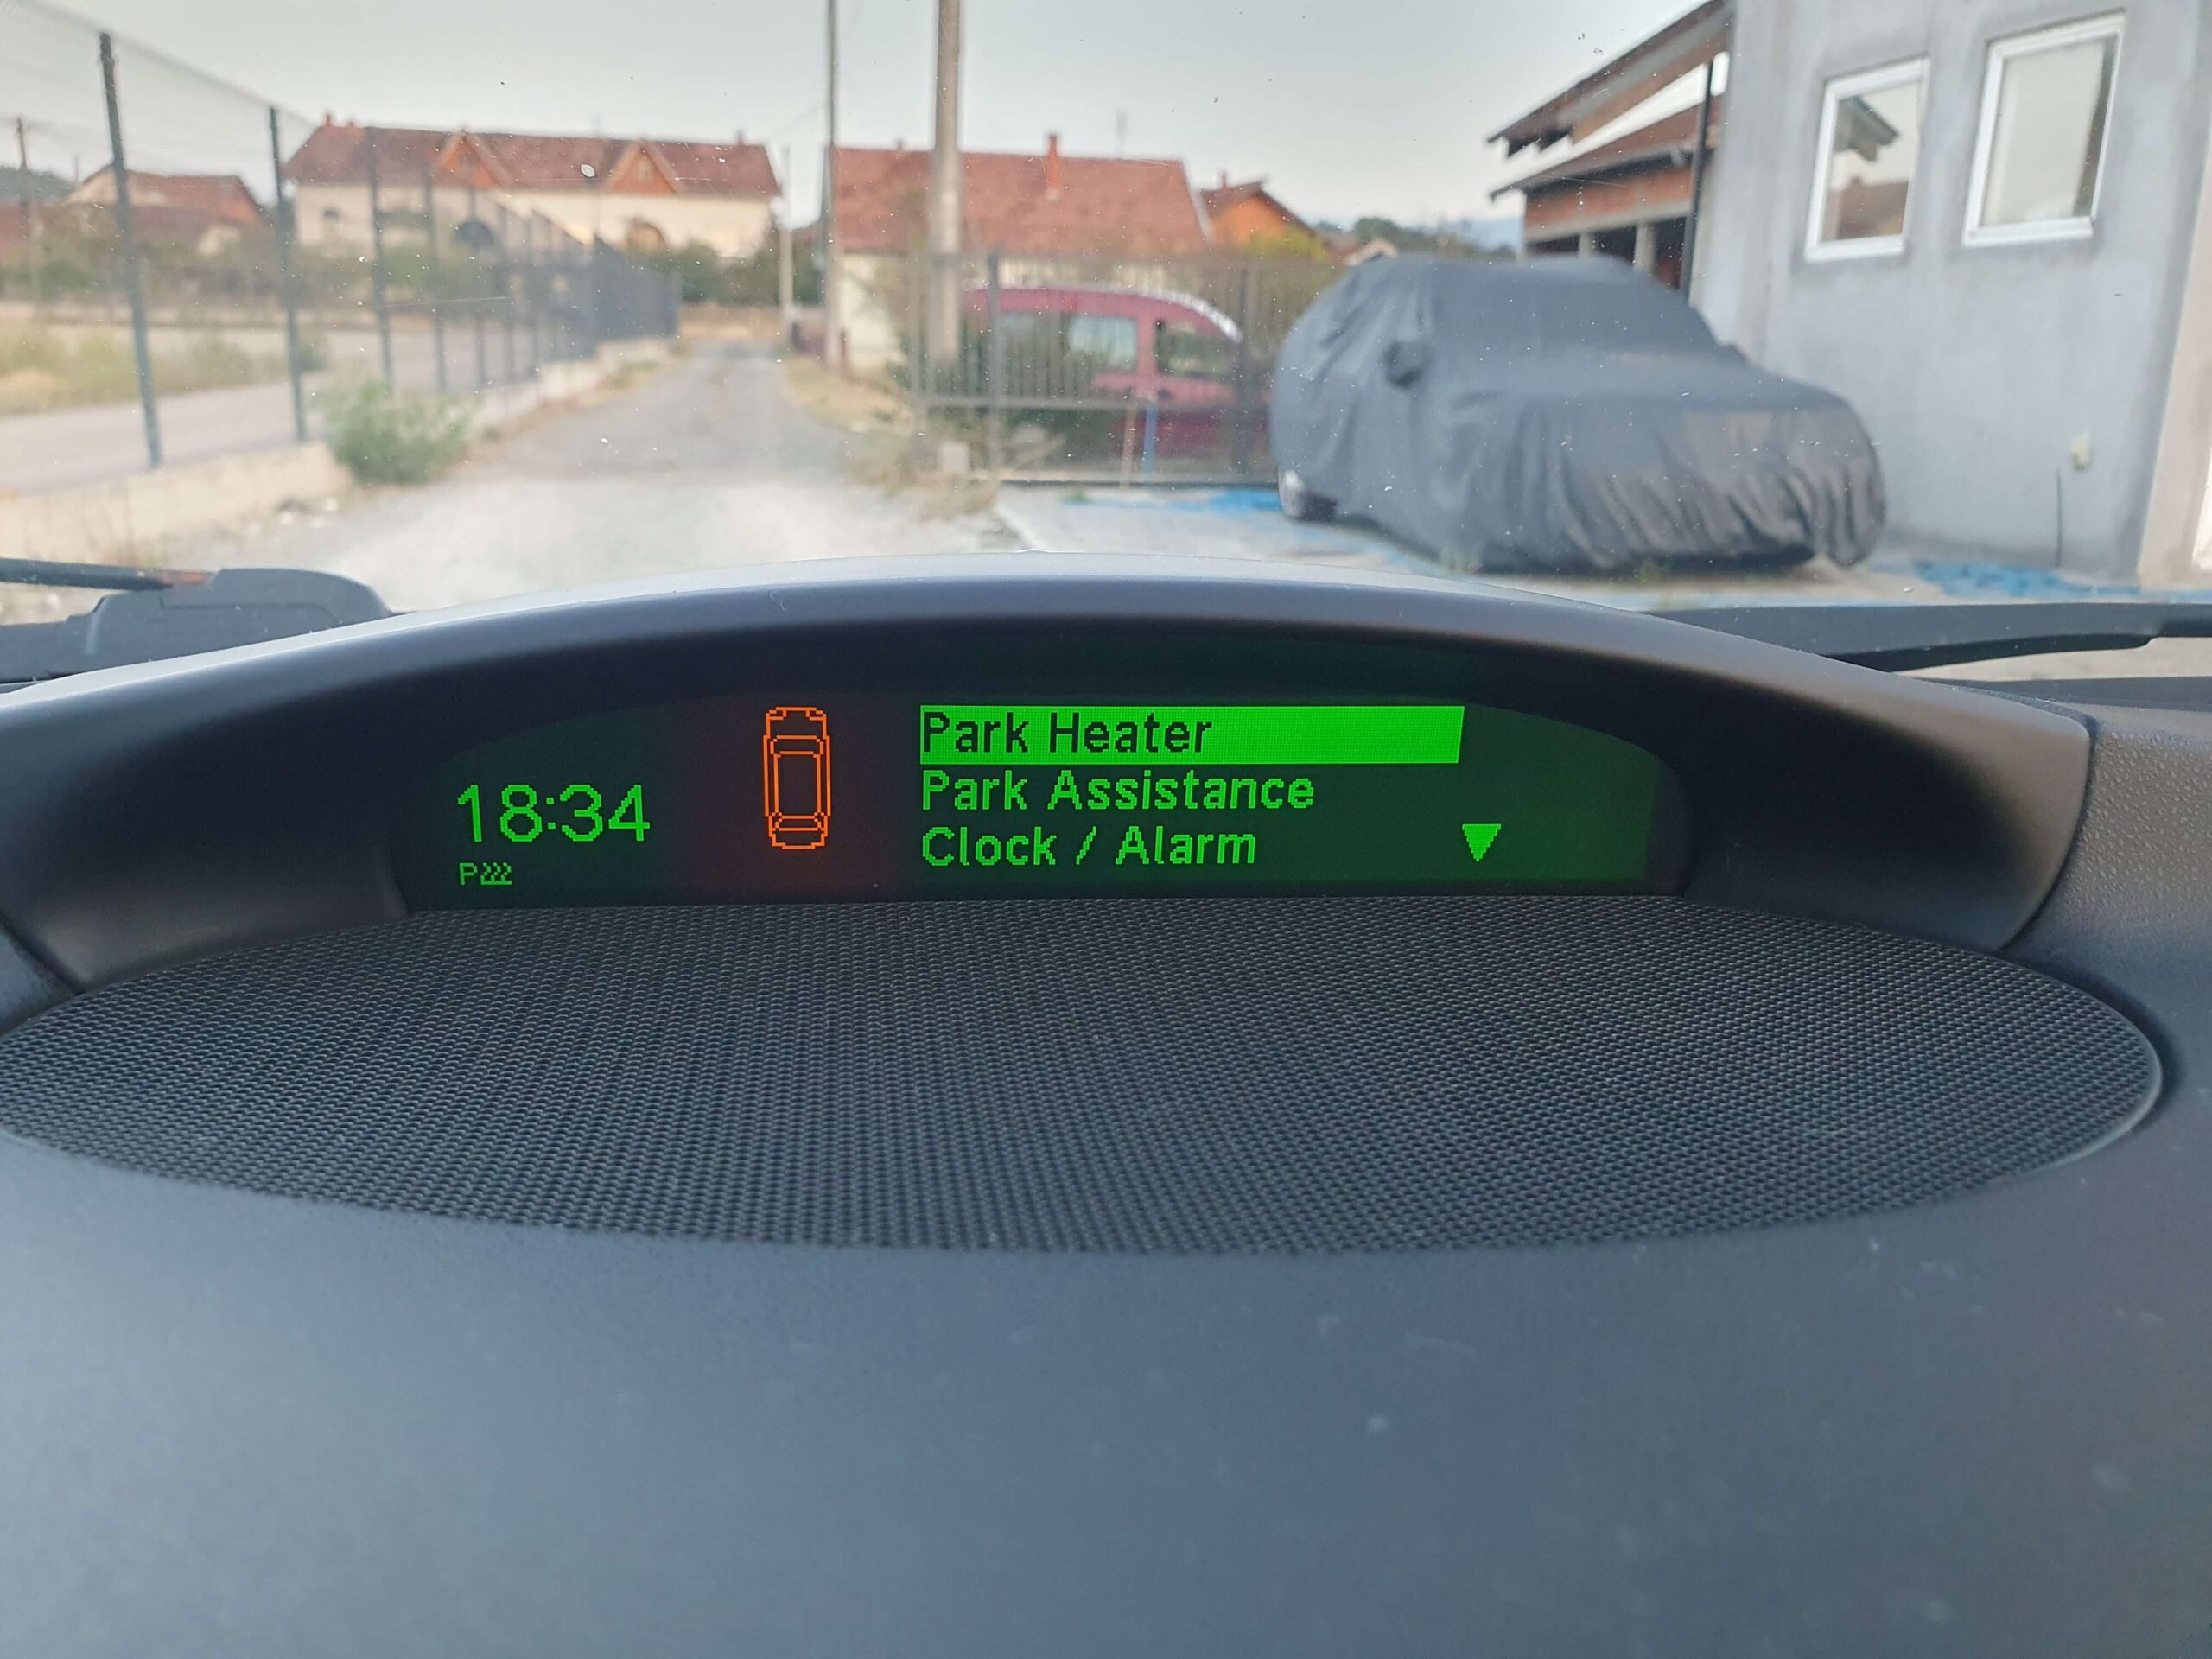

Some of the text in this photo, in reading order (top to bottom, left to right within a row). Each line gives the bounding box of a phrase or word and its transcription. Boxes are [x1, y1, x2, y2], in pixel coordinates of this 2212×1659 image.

[922, 711, 1212, 753] Park Heater
[921, 769, 1315, 810] Park Assistance
[457, 784, 651, 842] 18:34
[921, 824, 1257, 866] Clock / Alarm
